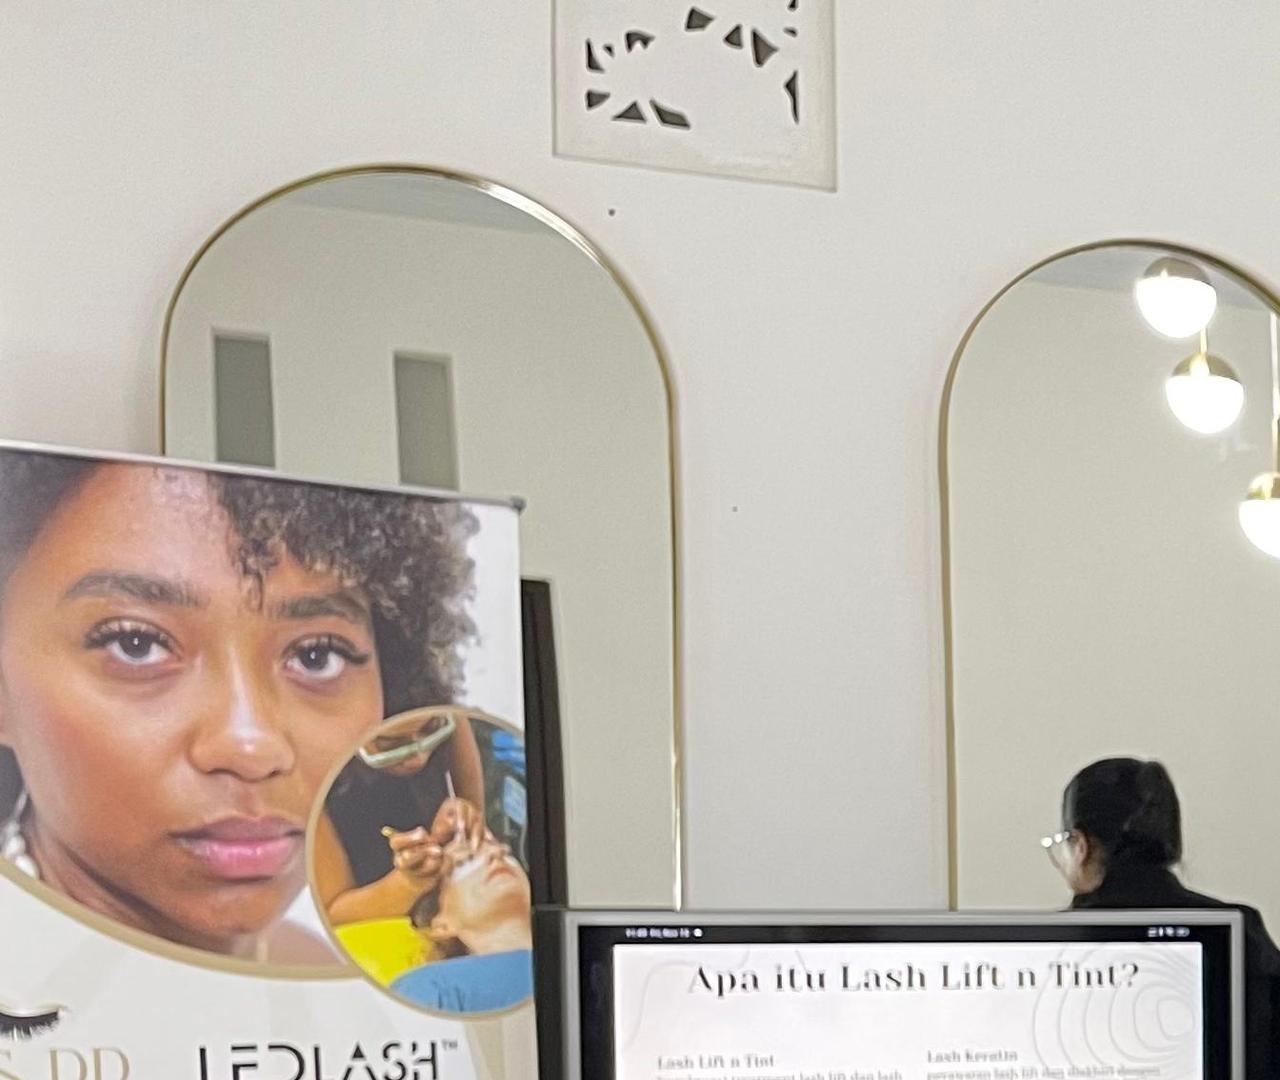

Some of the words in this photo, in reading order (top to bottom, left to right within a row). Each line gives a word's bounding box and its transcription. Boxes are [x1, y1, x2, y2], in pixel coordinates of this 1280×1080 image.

[688, 965, 760, 999] Apa
[775, 962, 826, 992] itu
[840, 961, 927, 992] Lash
[940, 961, 1005, 991] Lift
[1018, 968, 1037, 988] n
[1049, 962, 1139, 988] Tint?
